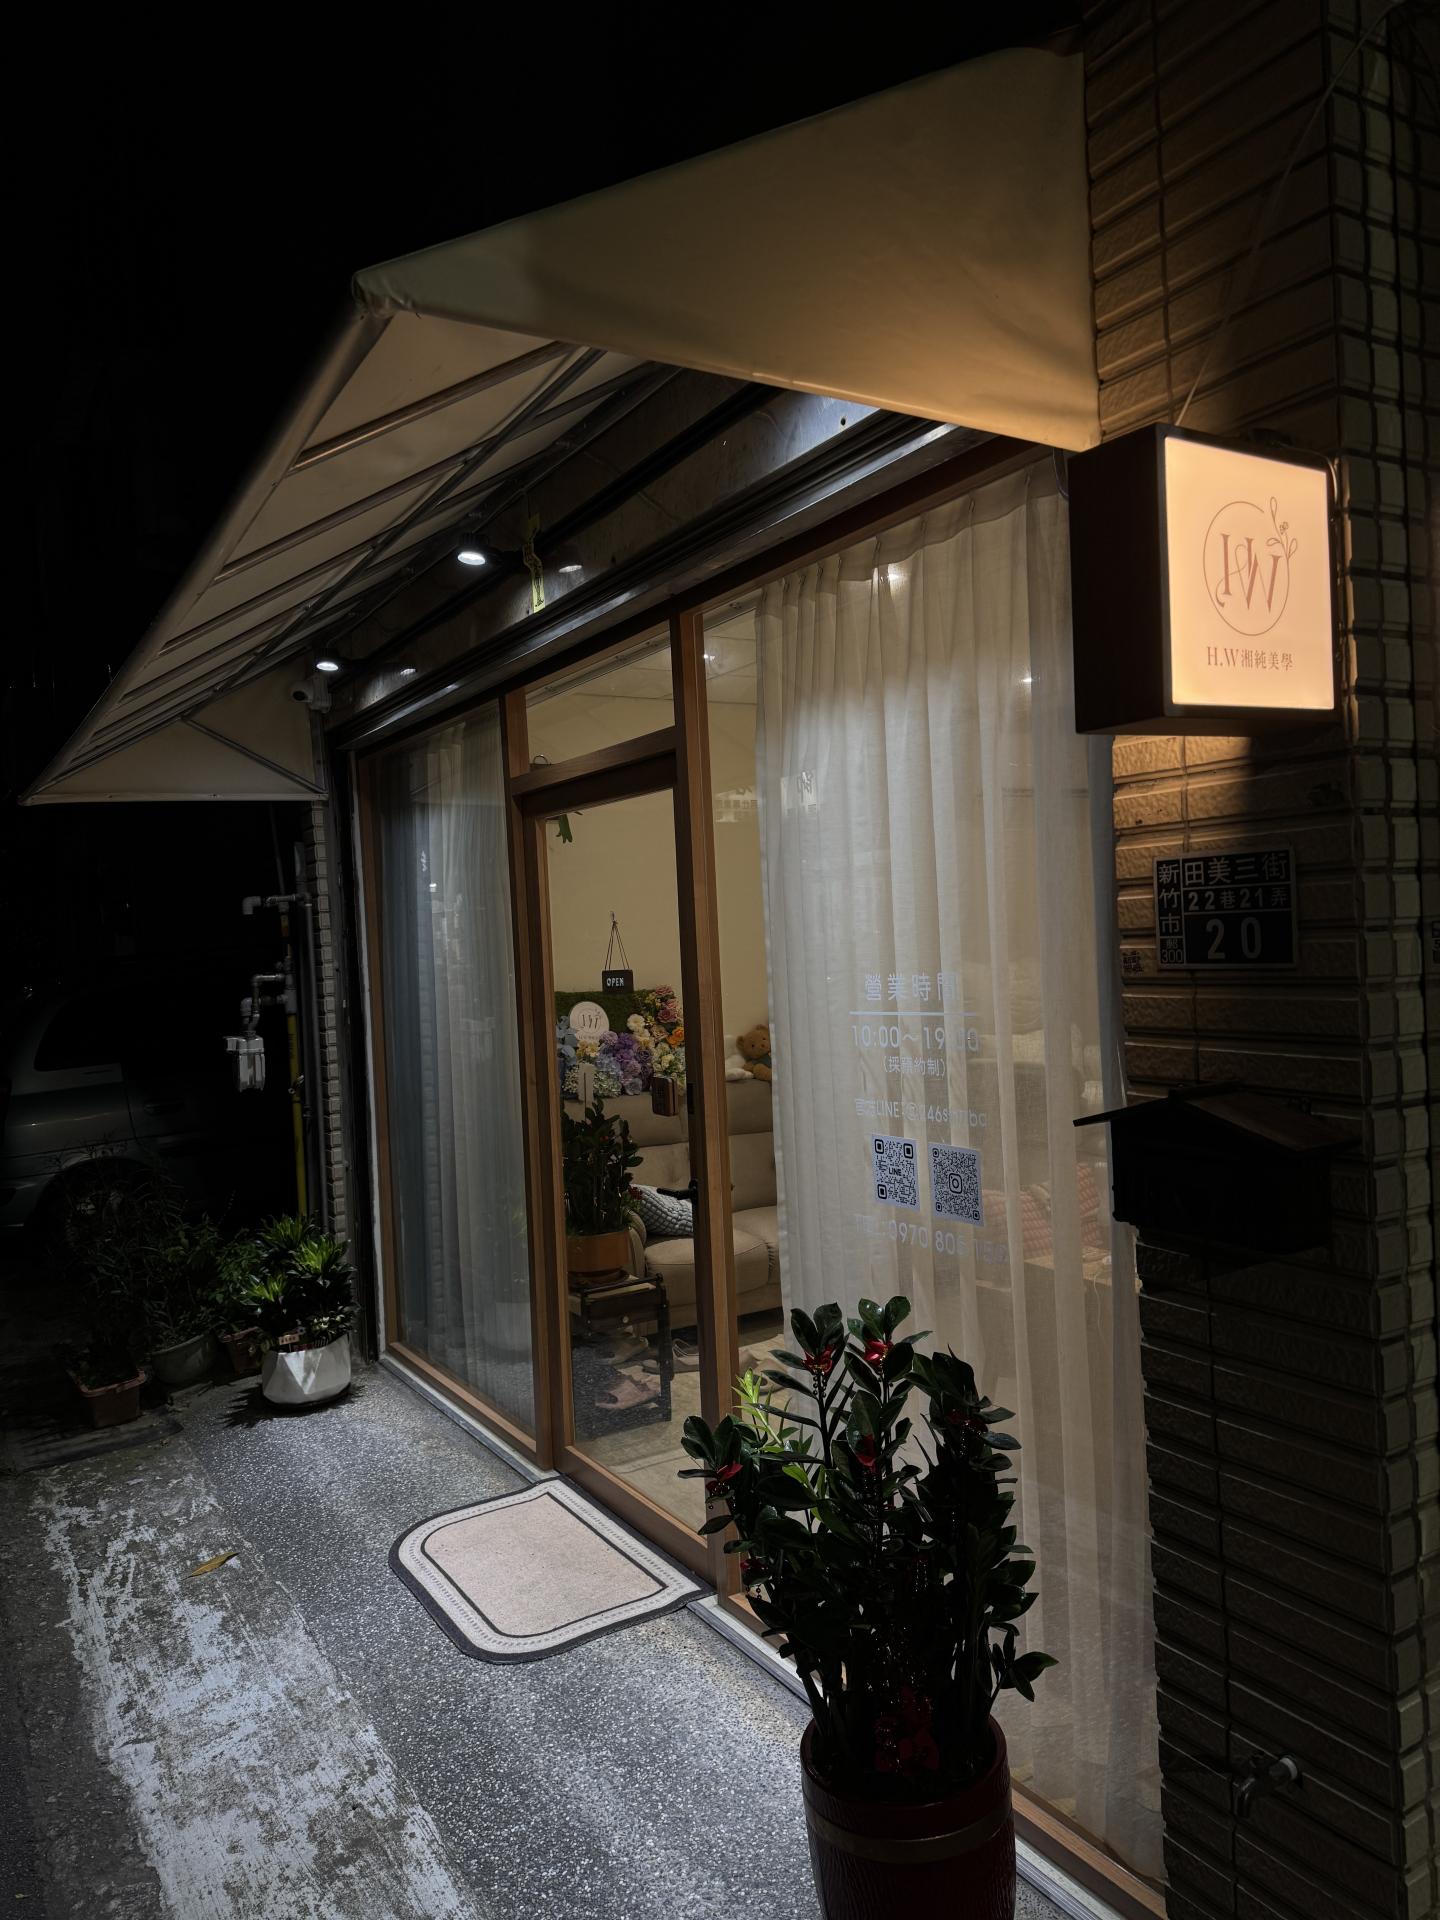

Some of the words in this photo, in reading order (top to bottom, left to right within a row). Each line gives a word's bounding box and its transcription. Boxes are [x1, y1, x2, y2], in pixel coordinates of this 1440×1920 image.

[1184, 853, 1288, 886] 田美三街
[1158, 863, 1181, 934] 新竹市
[1188, 887, 1289, 911] 22巷21弄
[1205, 917, 1263, 960] 20
[1161, 949, 1183, 963] 300
[606, 977, 625, 987] OPEN
[851, 1025, 980, 1052] 10:00~1900
[888, 1167, 902, 1176] LINE
